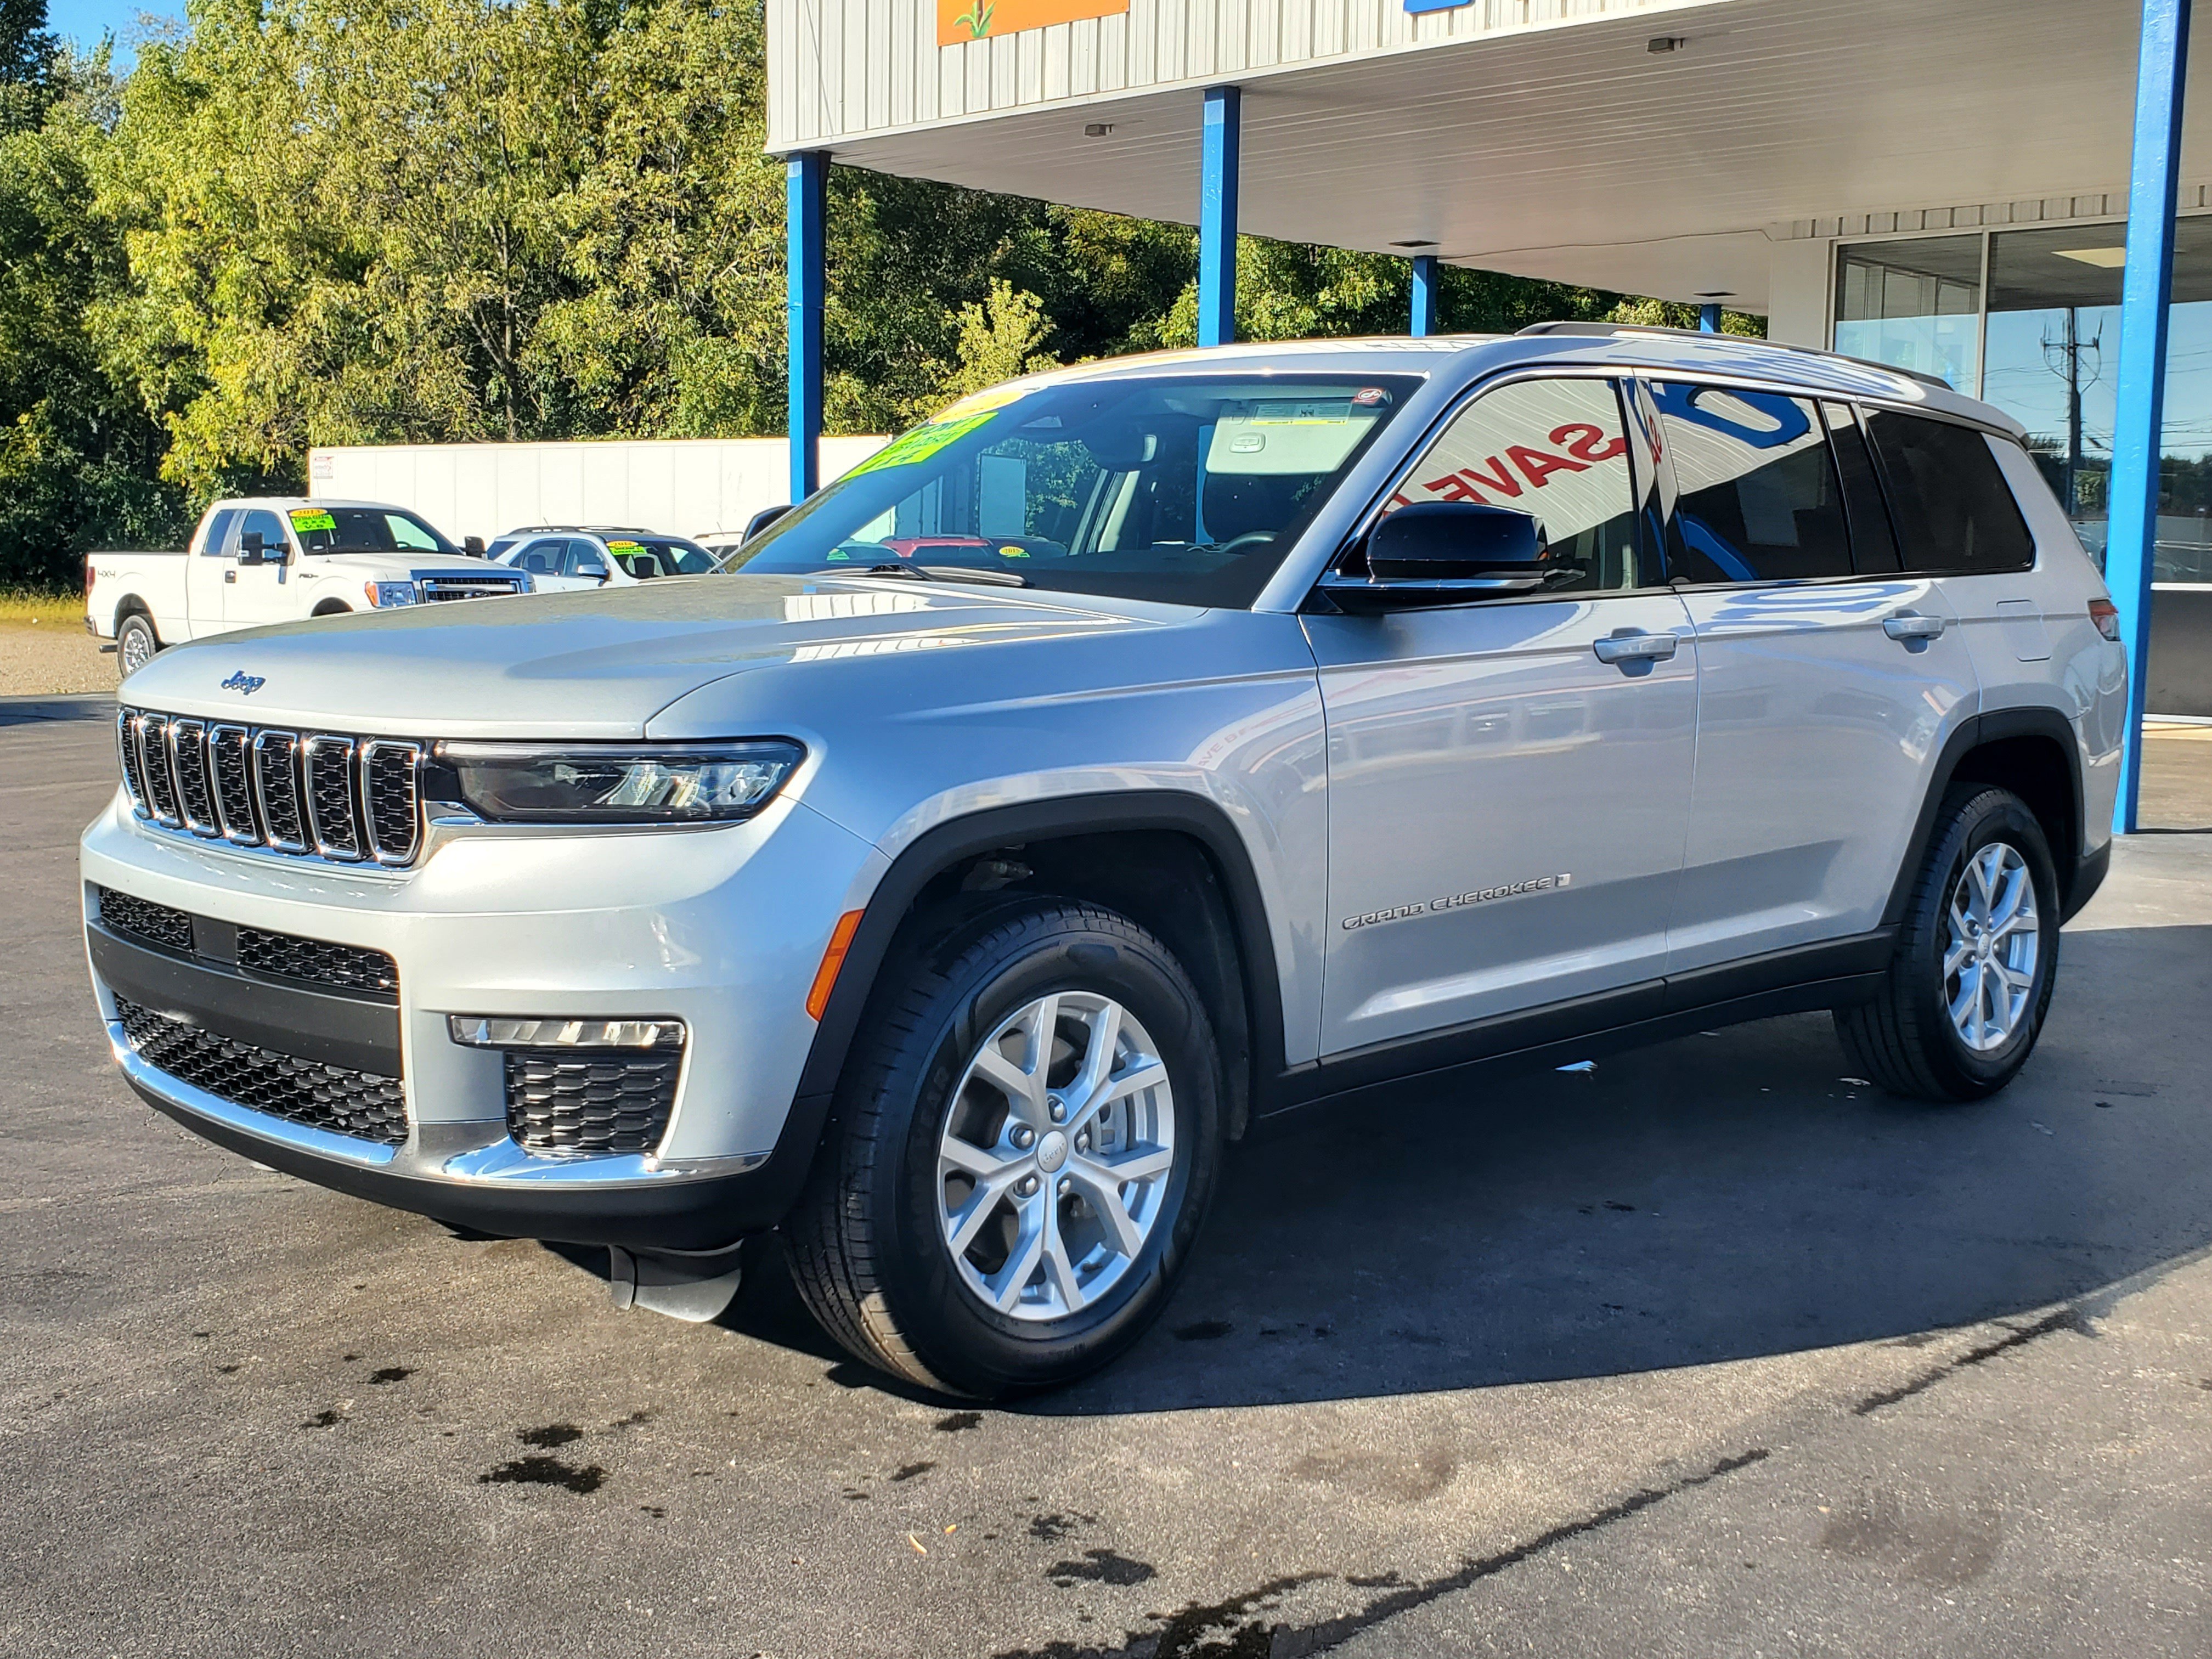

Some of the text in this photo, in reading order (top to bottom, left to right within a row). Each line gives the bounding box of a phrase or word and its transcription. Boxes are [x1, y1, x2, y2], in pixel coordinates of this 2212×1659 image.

[221, 670, 267, 696] Jeep
[1342, 902, 1424, 930] GRAND
[1430, 877, 1551, 911] CHEROKEE
